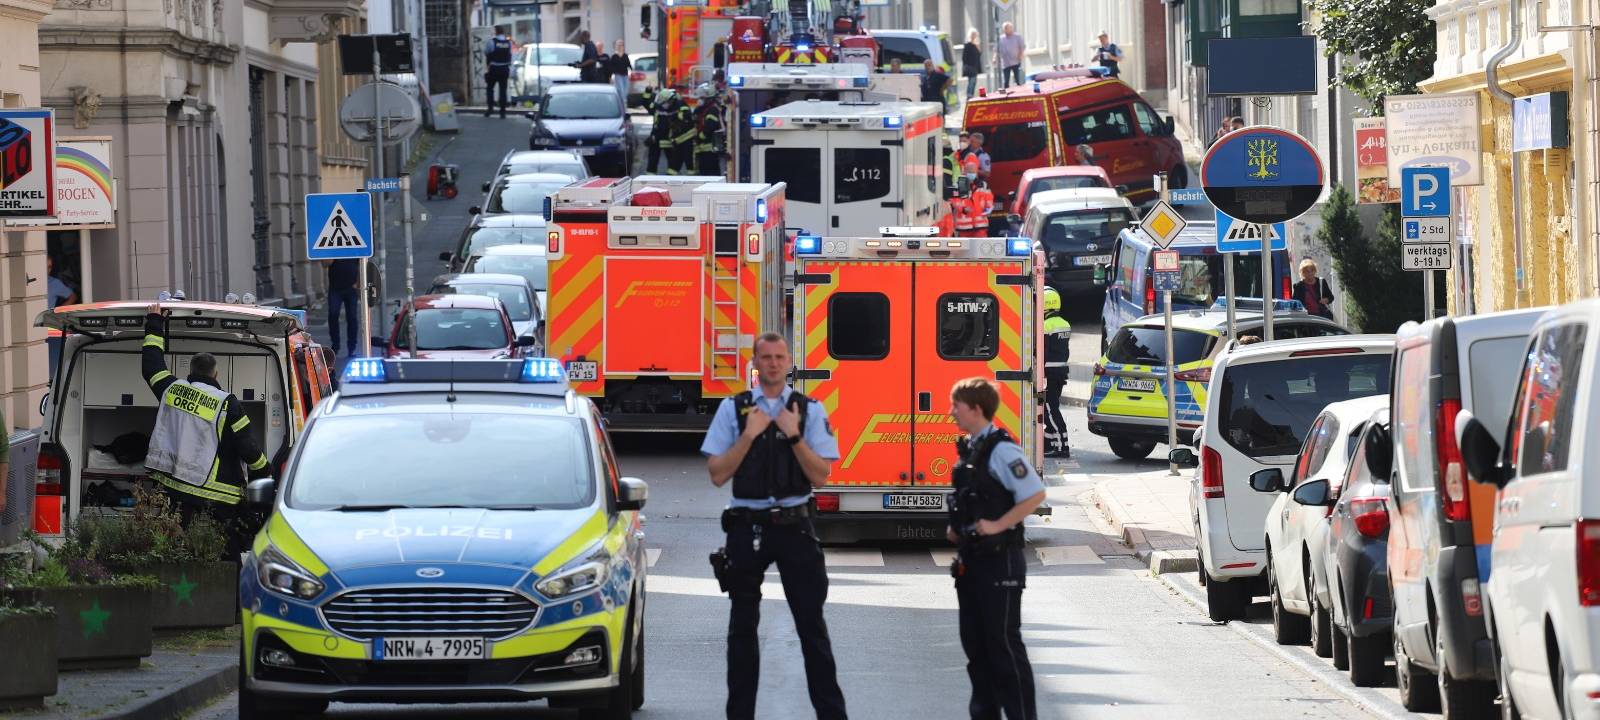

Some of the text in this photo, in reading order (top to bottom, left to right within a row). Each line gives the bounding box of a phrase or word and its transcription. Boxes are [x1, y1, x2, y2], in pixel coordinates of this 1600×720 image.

[861, 168, 881, 180] 112
[0, 190, 45, 199] RTIKEL
[1412, 173, 1439, 211] P
[1422, 226, 1446, 234] 2 Std.
[1407, 246, 1448, 257] werktags
[1414, 258, 1441, 267] 8-19 h
[947, 301, 988, 313] 5-RTW-2
[167, 383, 220, 411] FEUERWEHR HAGEN
[260, 393, 265, 401] 3
[173, 396, 200, 415] ORGL
[890, 496, 941, 506] HA FW 5832
[355, 526, 513, 541] POLIZEI
[384, 640, 415, 657] NRW
